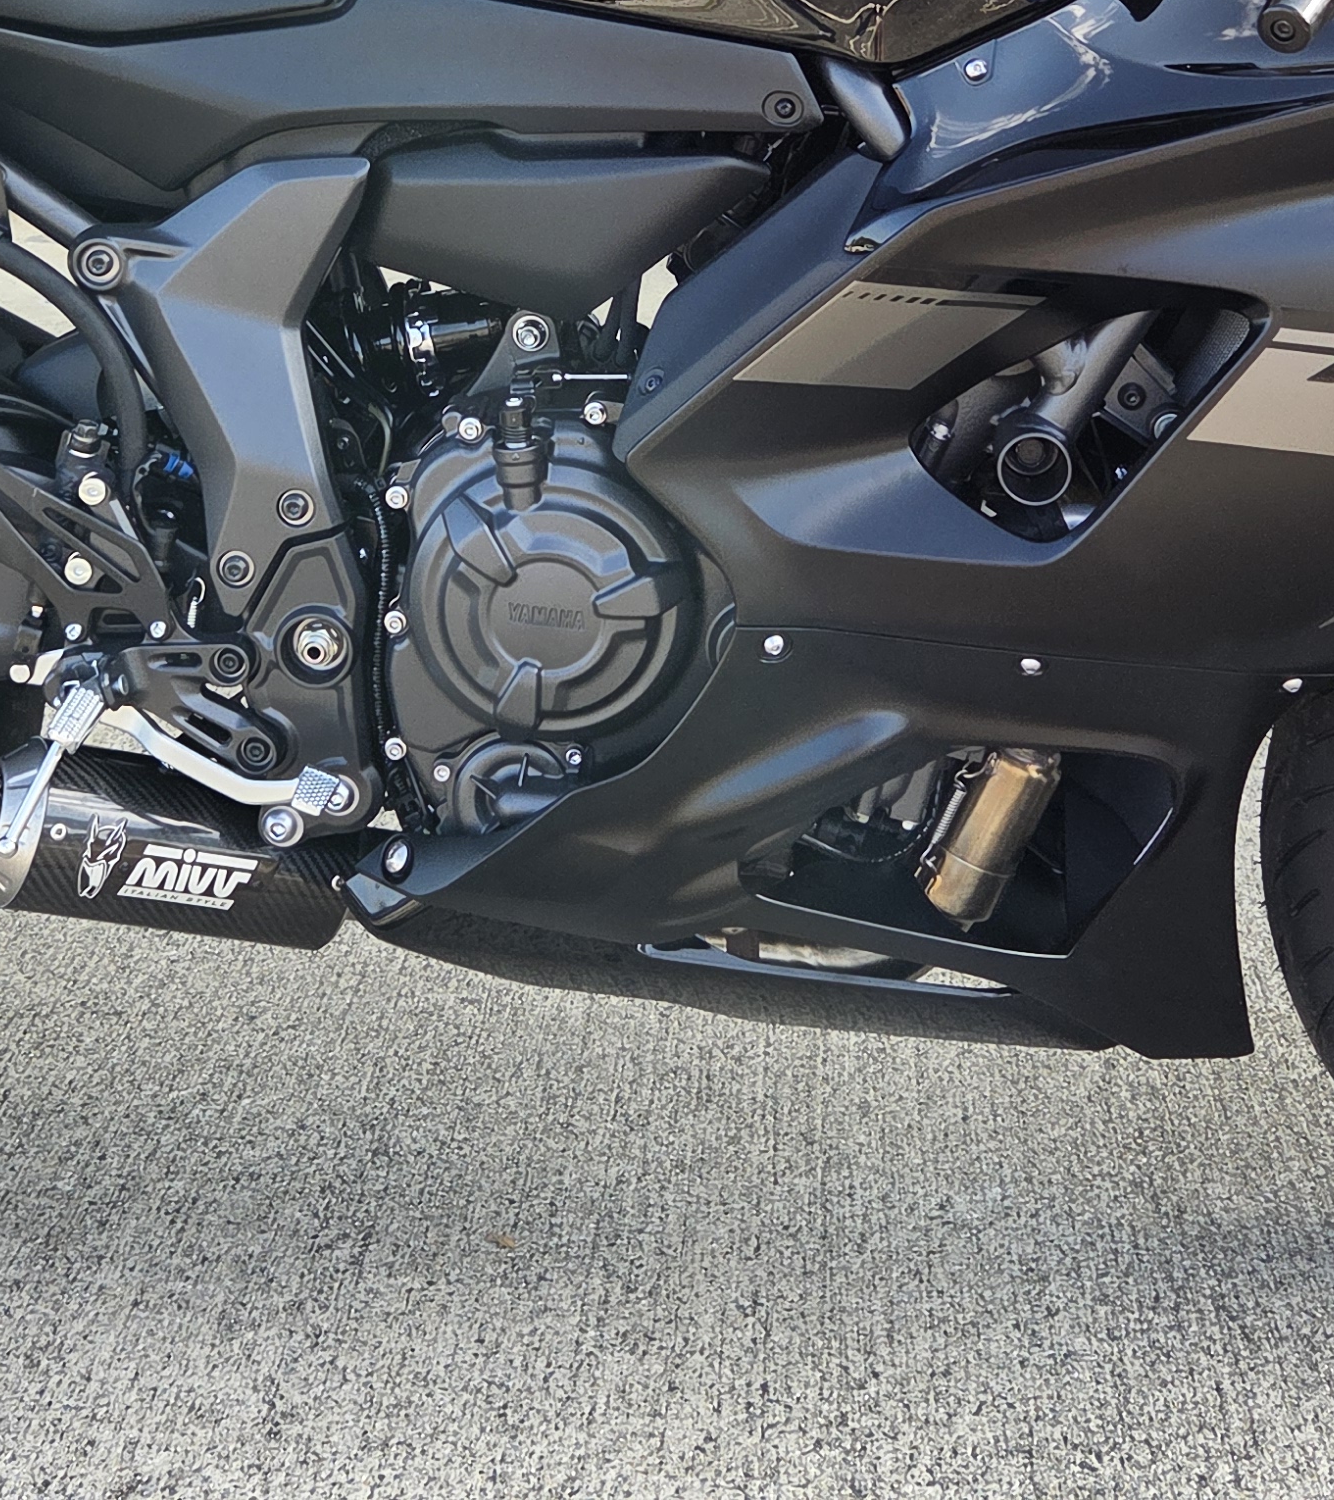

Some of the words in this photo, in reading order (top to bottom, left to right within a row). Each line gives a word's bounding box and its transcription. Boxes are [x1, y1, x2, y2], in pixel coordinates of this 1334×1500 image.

[507, 601, 587, 632] YAMAHA
[123, 888, 179, 901] ITALIAN
[185, 896, 228, 908] STYLE
